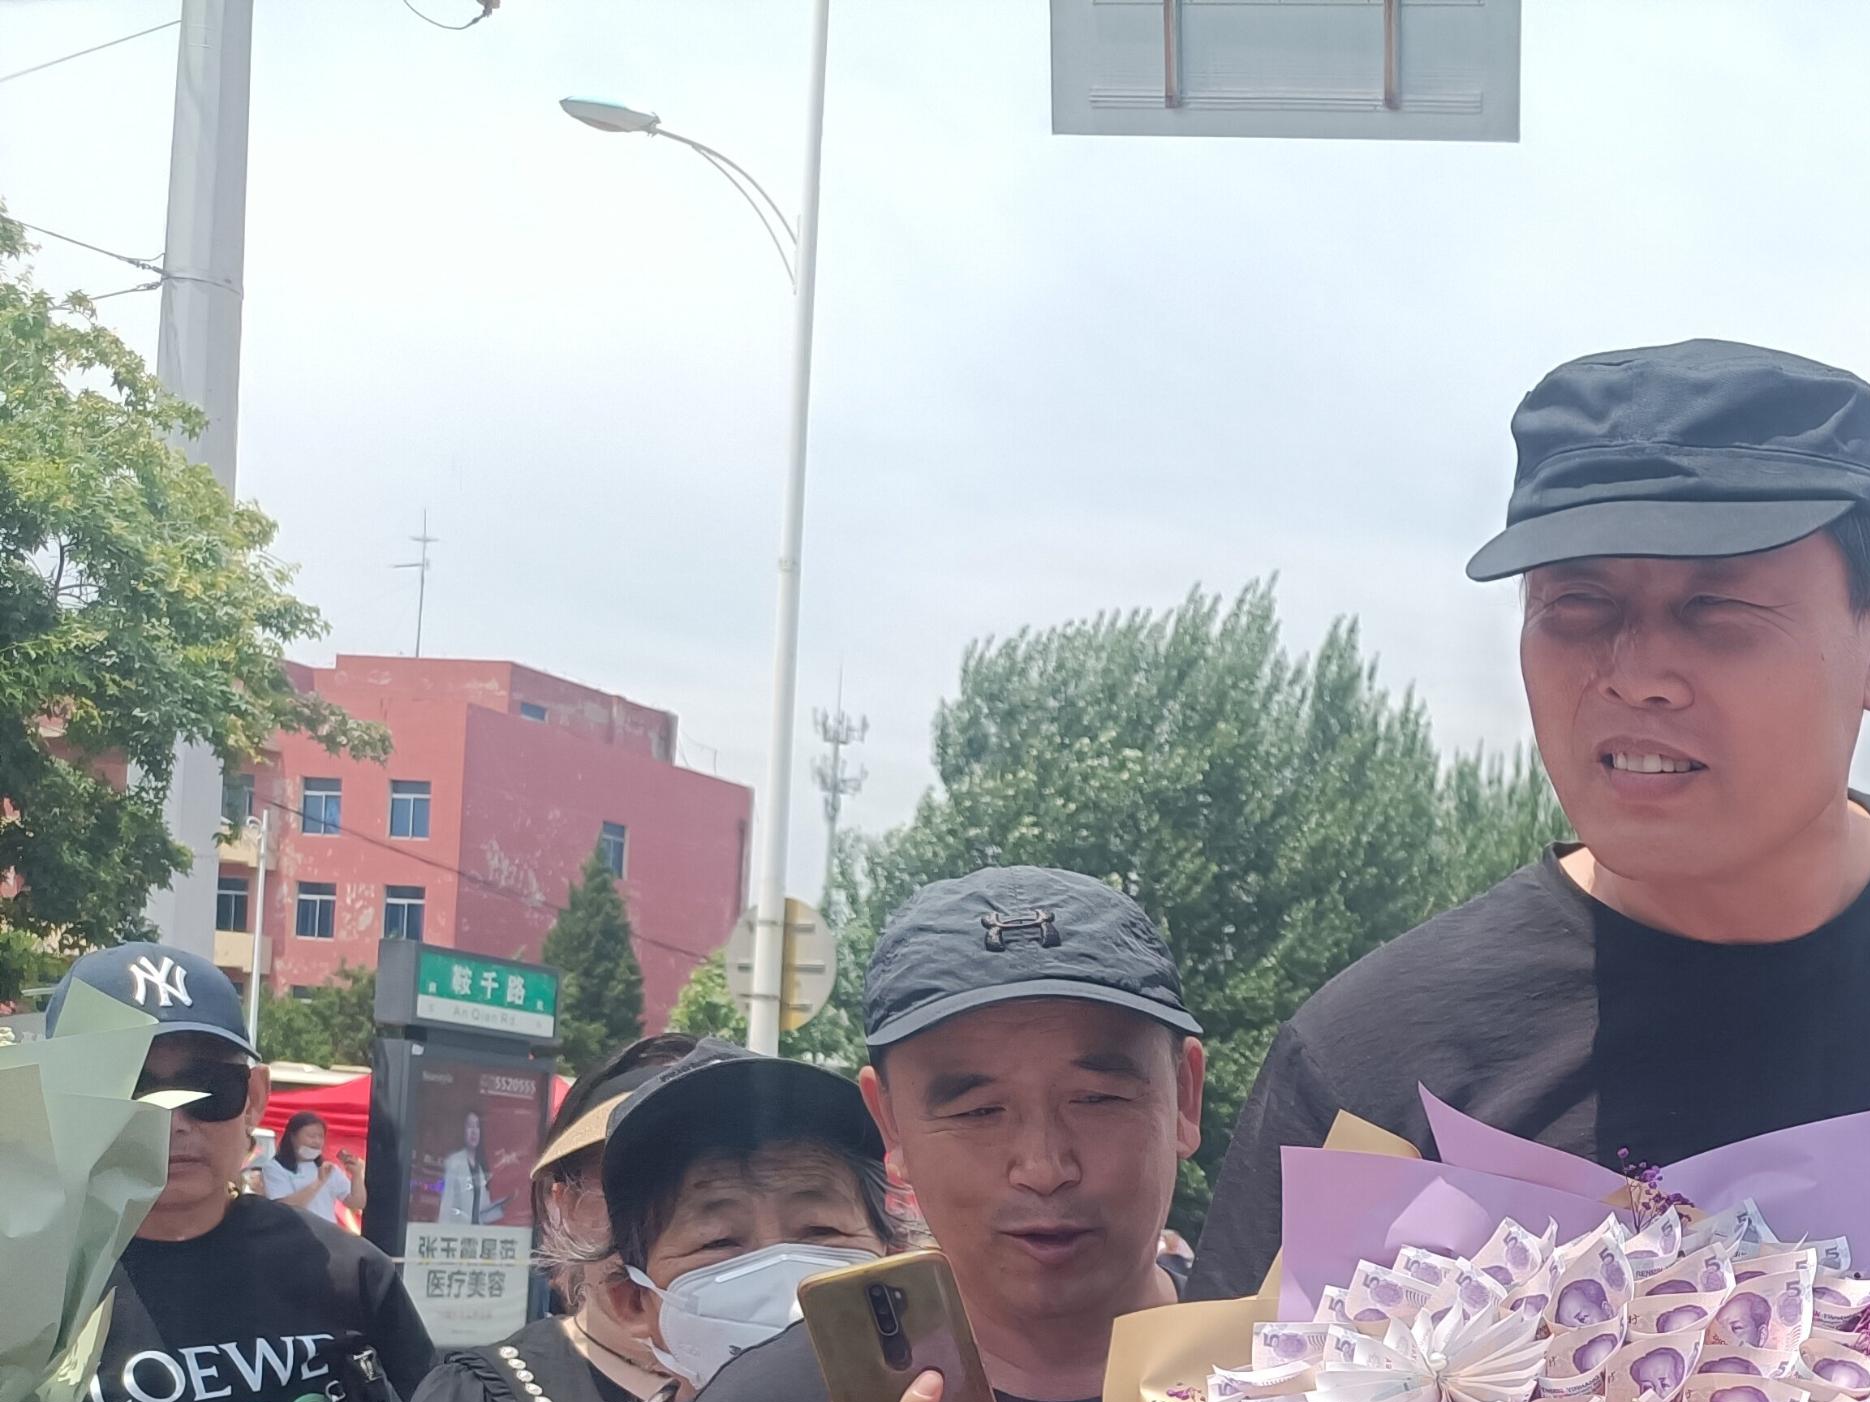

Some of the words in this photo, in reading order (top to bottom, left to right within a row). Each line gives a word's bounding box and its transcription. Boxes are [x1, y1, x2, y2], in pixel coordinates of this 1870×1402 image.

[129, 955, 194, 1007] NY
[451, 963, 526, 1006] 鞍千路
[1661, 1220, 1674, 1236] 5
[1599, 1247, 1616, 1266] 5
[1825, 1246, 1840, 1261] 5
[1404, 1256, 1421, 1271] 5
[1704, 1255, 1721, 1272] 5
[426, 1269, 506, 1298] 医疗美容
[1363, 1273, 1381, 1289] 5
[1456, 1270, 1473, 1287] 5
[1786, 1280, 1802, 1298] 5
[1328, 1296, 1345, 1312] 5
[1263, 1333, 1281, 1348] 5
[1777, 1360, 1789, 1376] 5
